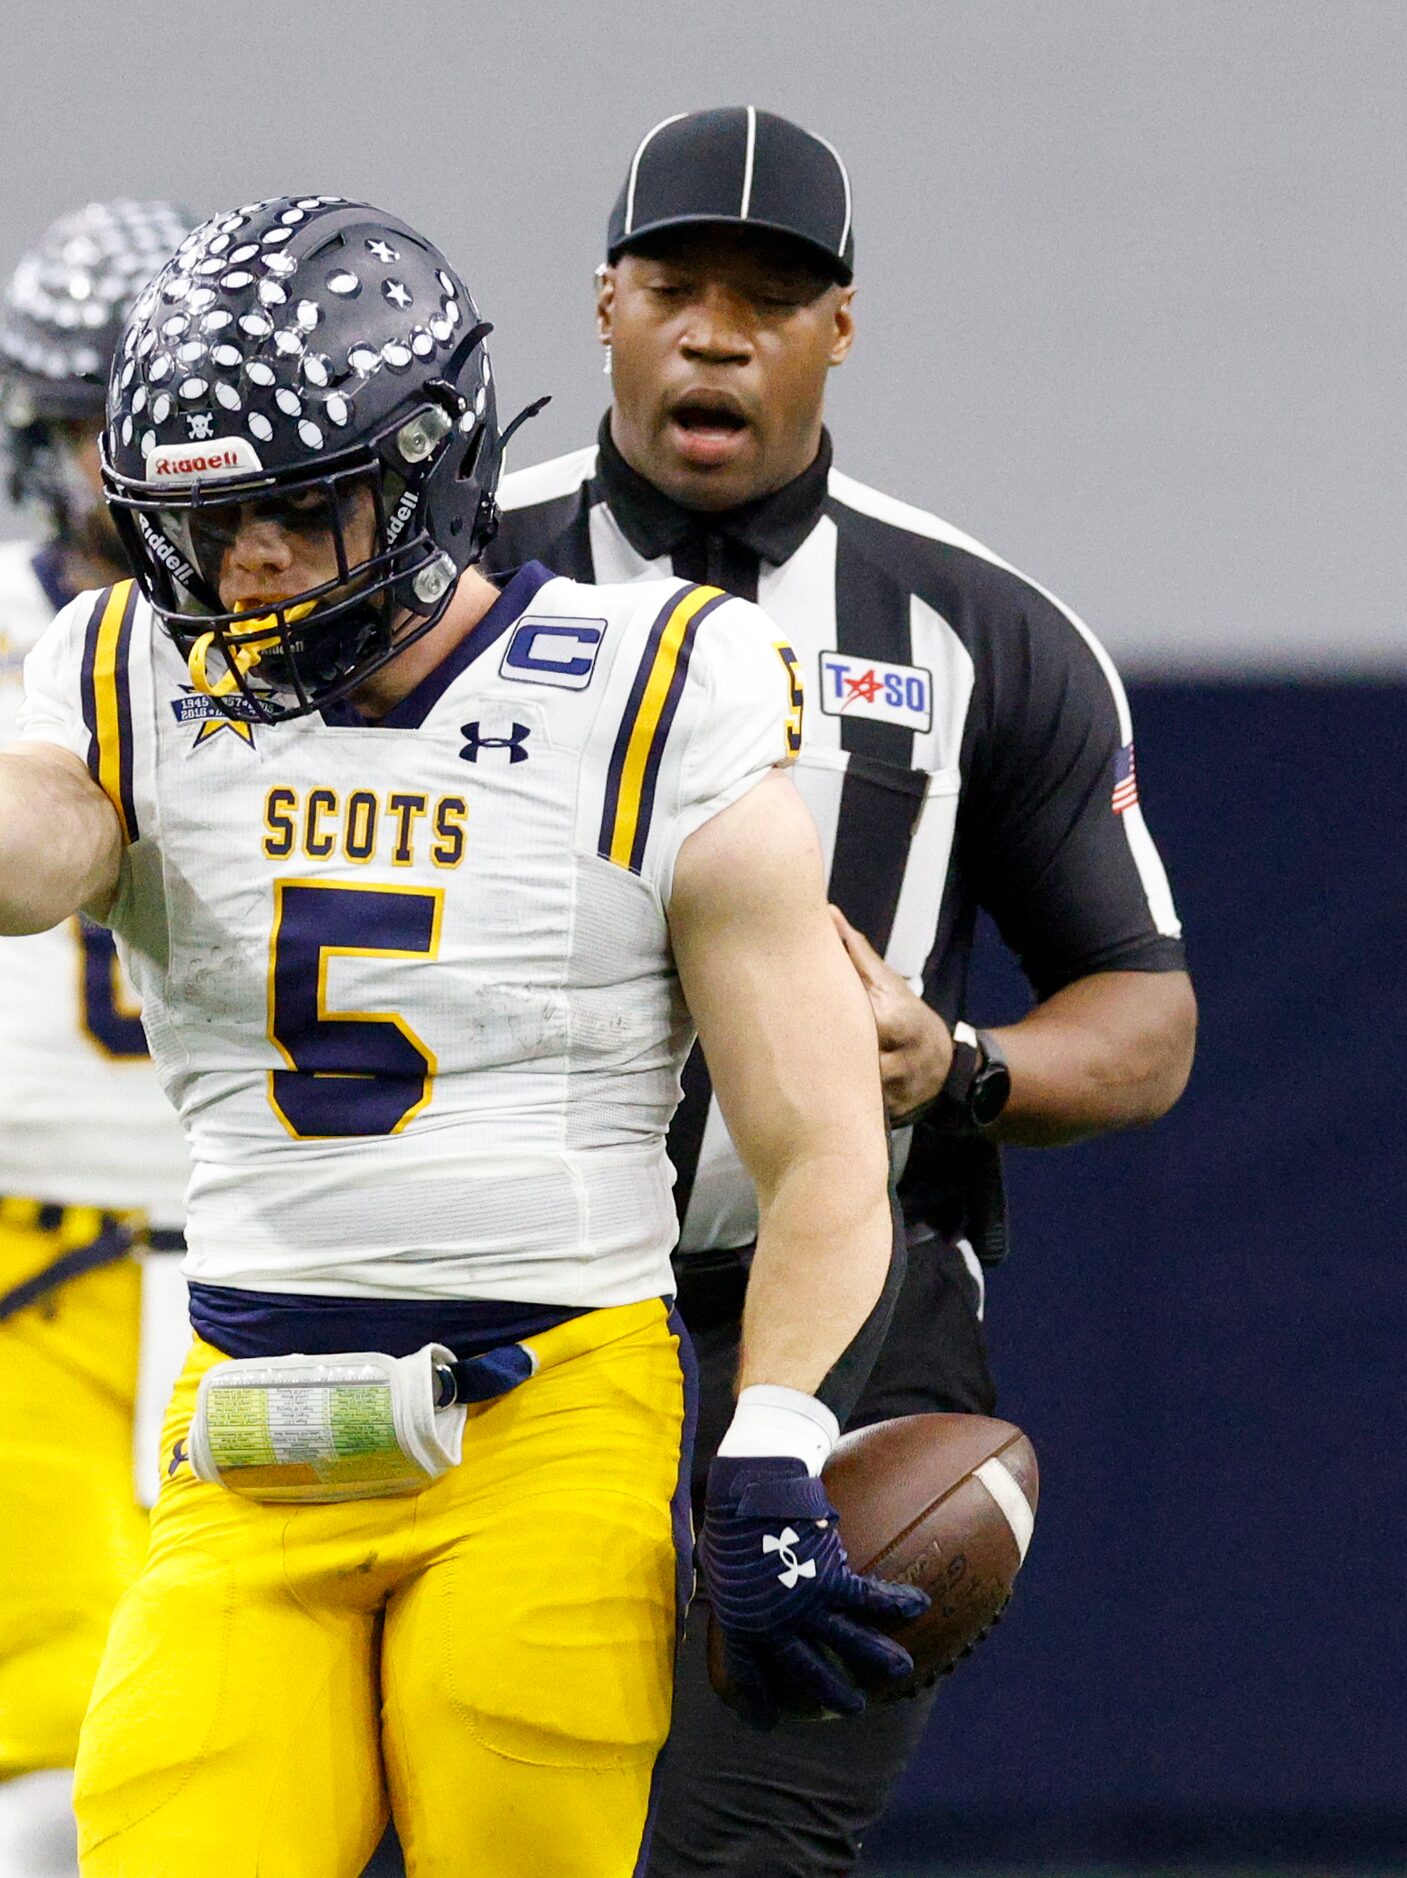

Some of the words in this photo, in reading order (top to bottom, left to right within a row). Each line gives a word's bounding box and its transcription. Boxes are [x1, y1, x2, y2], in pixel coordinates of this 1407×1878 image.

[139, 512, 194, 583] Riddell
[506, 624, 601, 676] C
[180, 707, 207, 720] 2016
[181, 698, 209, 710] 1945
[261, 784, 469, 869] SCOTS
[266, 877, 445, 1141] 5
